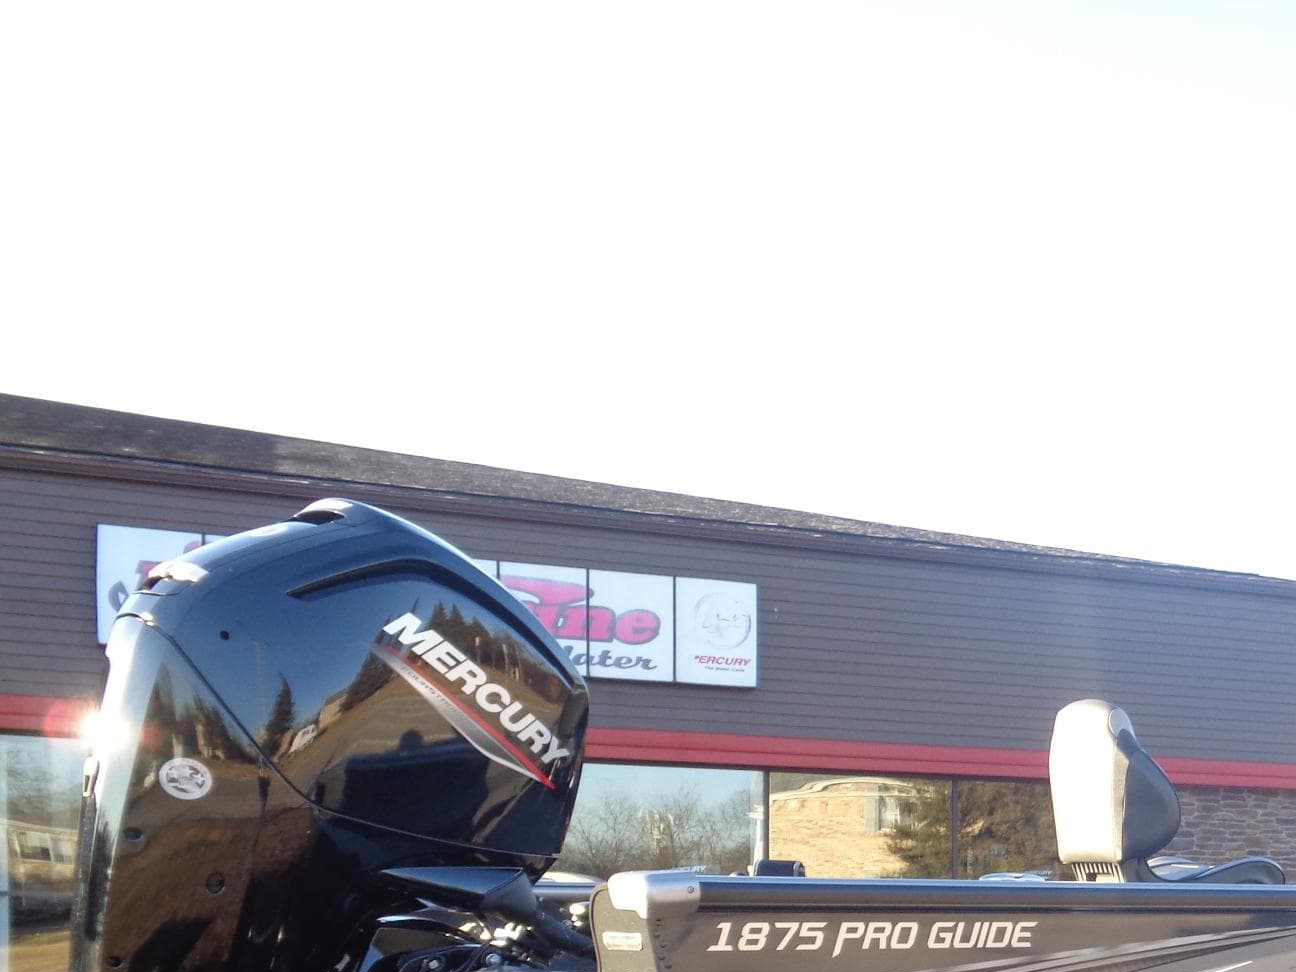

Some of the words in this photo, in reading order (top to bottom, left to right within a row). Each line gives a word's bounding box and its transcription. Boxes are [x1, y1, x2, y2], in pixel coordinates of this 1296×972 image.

[382, 612, 570, 764] MERCURY
[706, 921, 828, 951] 1875
[832, 921, 918, 958] PRO
[927, 921, 1039, 949] GUIDE
